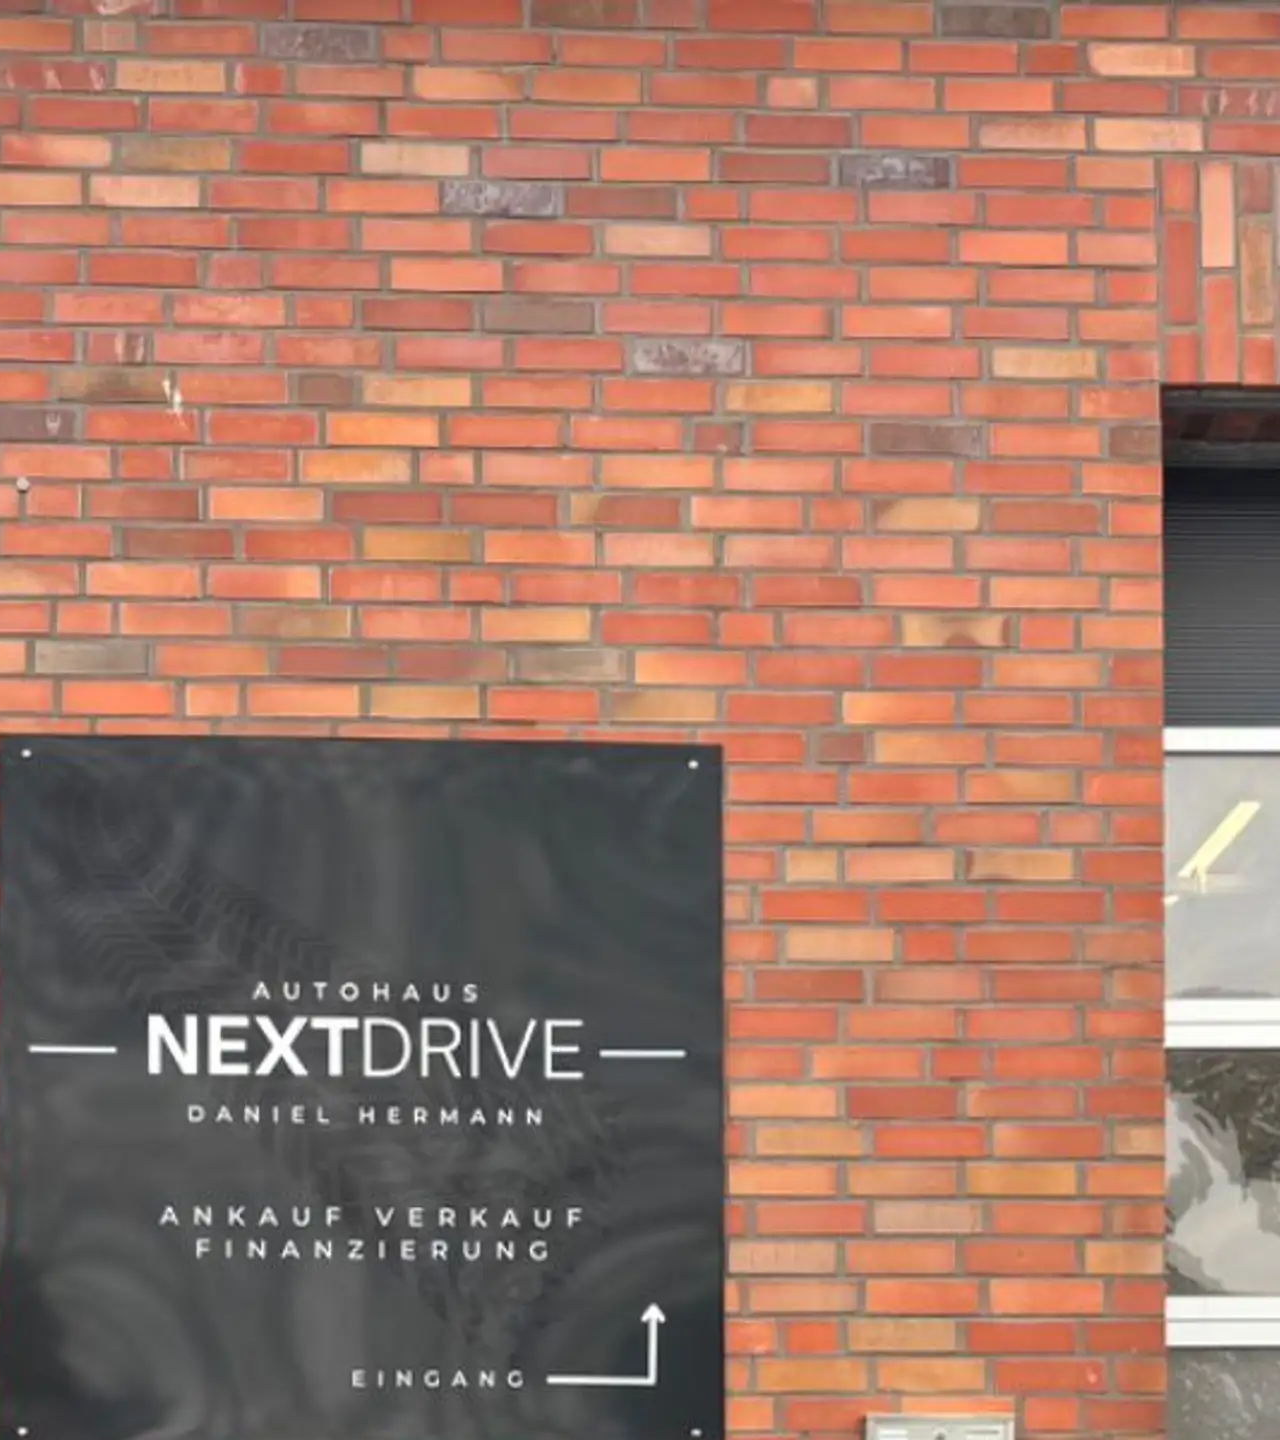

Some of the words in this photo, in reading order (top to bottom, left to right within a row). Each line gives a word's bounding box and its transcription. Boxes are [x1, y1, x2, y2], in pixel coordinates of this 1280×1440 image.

[252, 981, 478, 1003] AUTOHAUS
[147, 1013, 584, 1080] NEXTDRIVE
[187, 1104, 330, 1125] DANIEL
[358, 1106, 543, 1126] HERMANN
[159, 1205, 341, 1227] ANKAUF
[375, 1206, 582, 1229] VERKAUF
[195, 1237, 548, 1262] FINANZIERUNG
[351, 1369, 524, 1389] EINGANG
